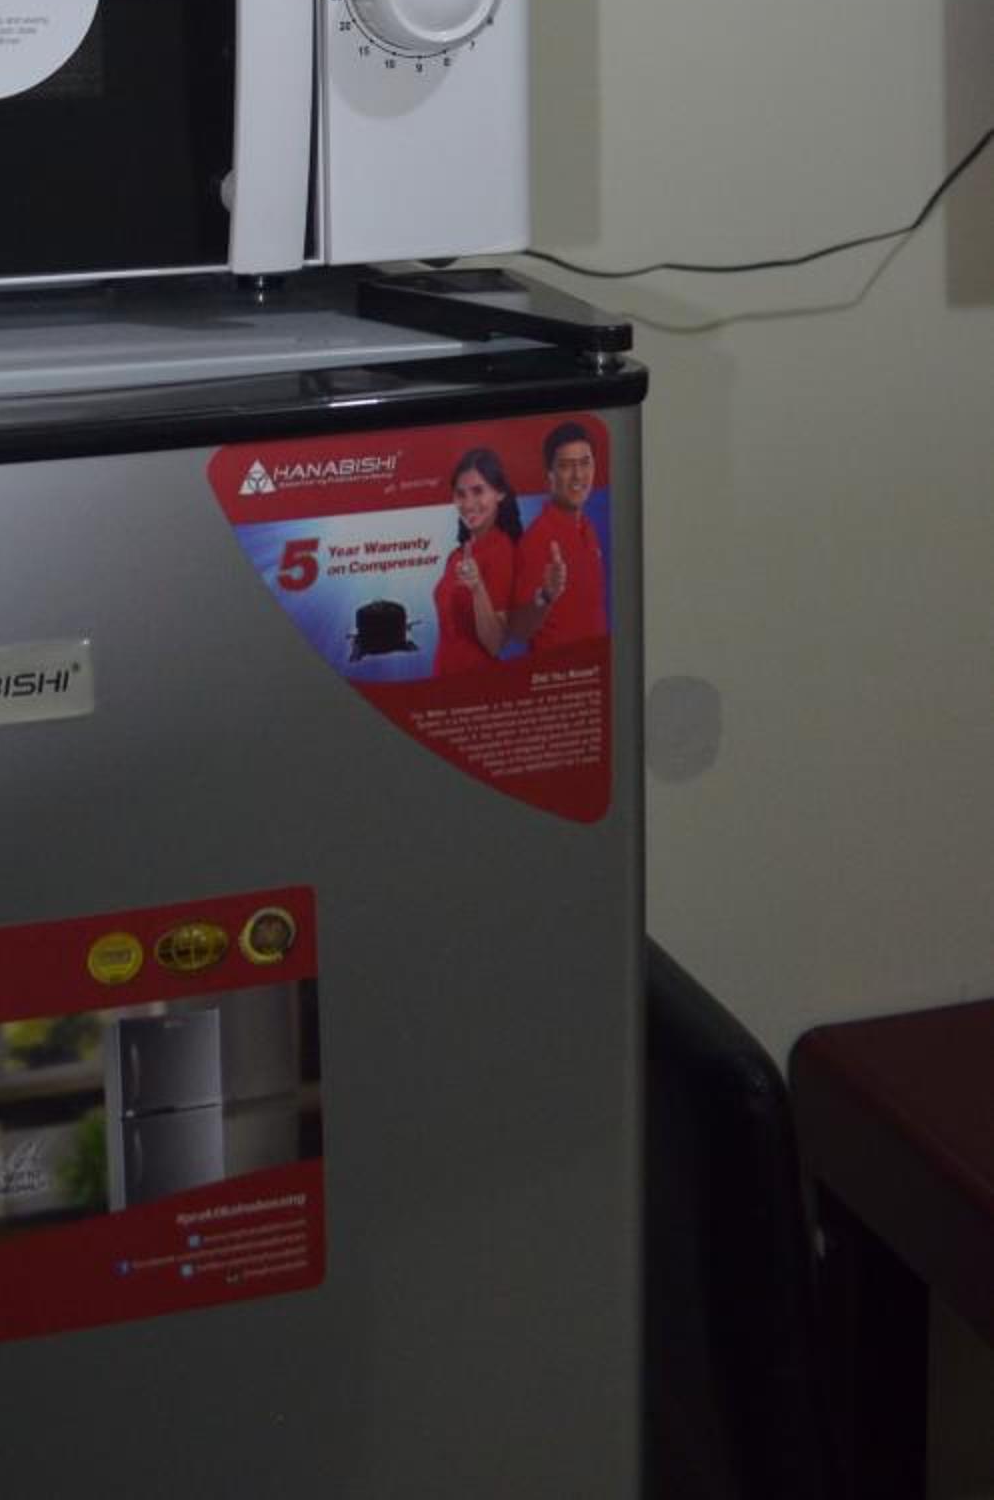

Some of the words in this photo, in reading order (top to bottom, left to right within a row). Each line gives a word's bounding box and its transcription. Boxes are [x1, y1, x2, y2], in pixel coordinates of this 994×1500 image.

[273, 455, 398, 481] HANABISHI
[327, 543, 361, 558] Year
[363, 536, 431, 555] Warranty
[277, 537, 320, 593] 5
[326, 564, 346, 576] on
[349, 553, 440, 575] Compressor
